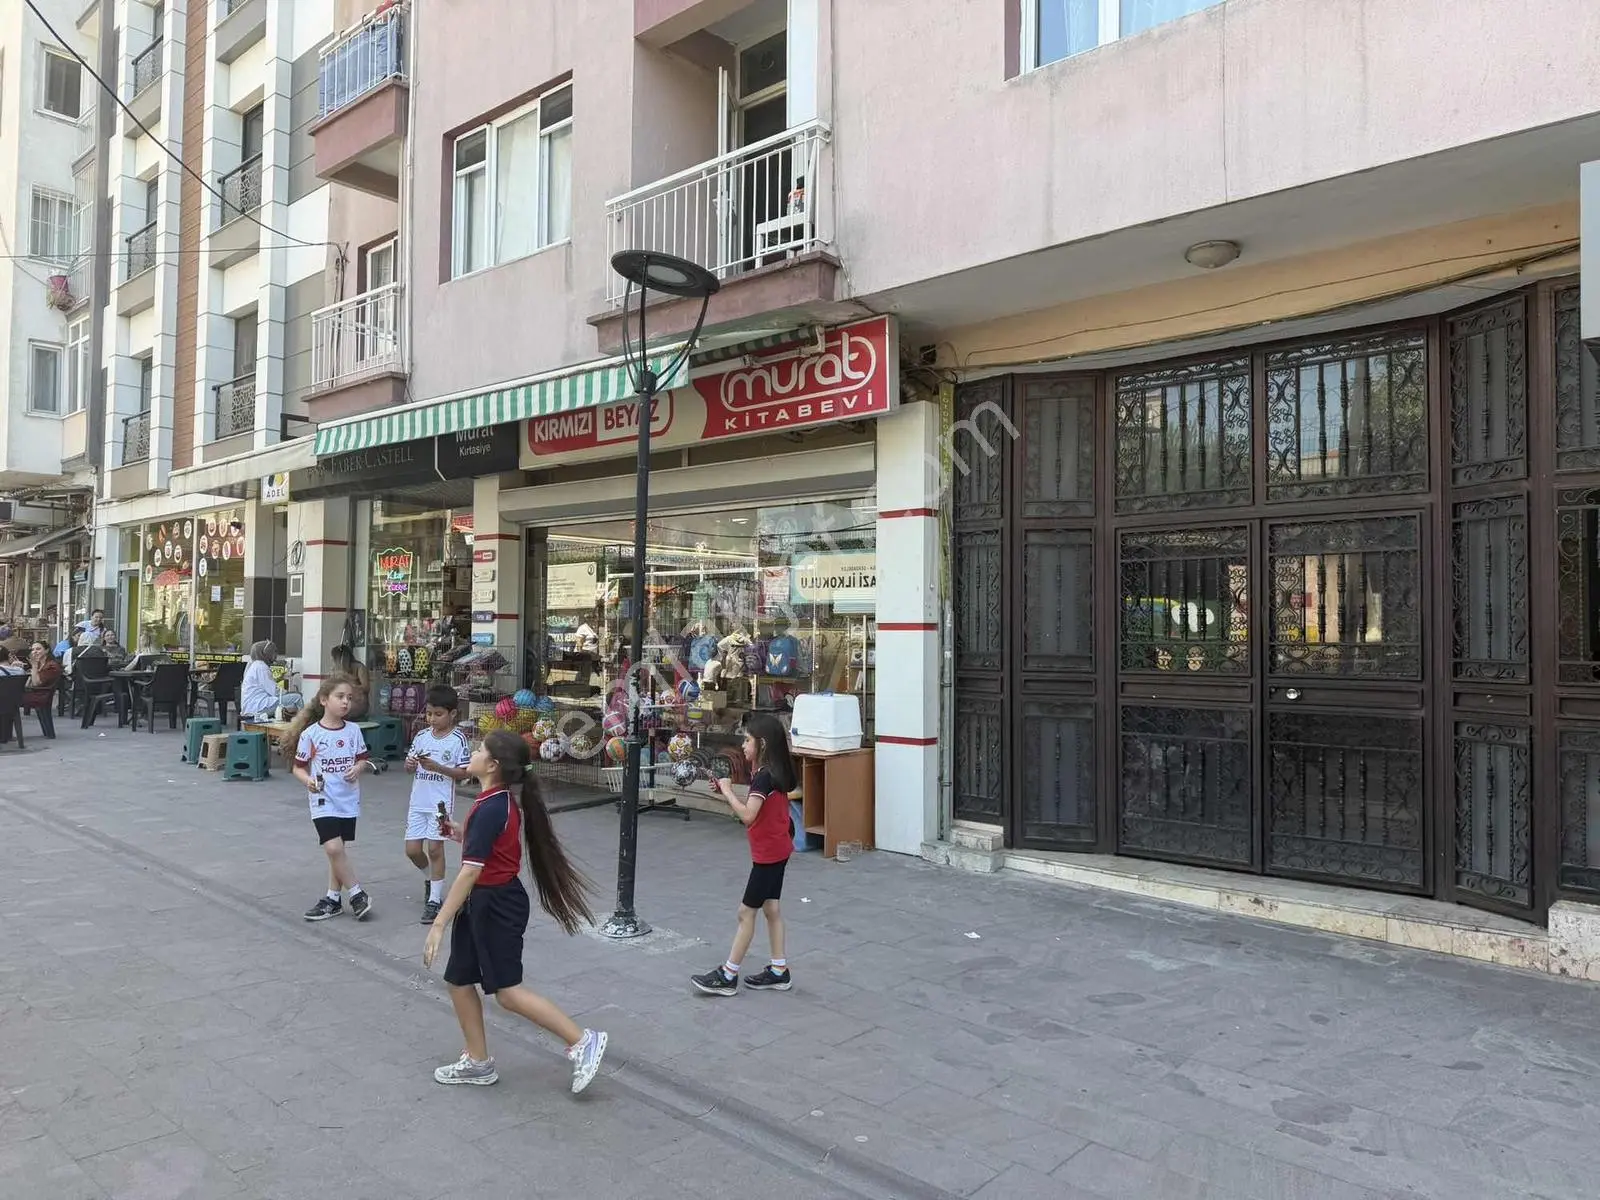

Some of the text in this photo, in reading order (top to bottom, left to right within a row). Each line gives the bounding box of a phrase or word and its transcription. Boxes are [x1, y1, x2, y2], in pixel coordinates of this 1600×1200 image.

[727, 331, 868, 403] murat
[534, 411, 592, 443] KIRMIZI
[724, 390, 873, 430] KİTABEVİ
[266, 487, 285, 498] ADEL
